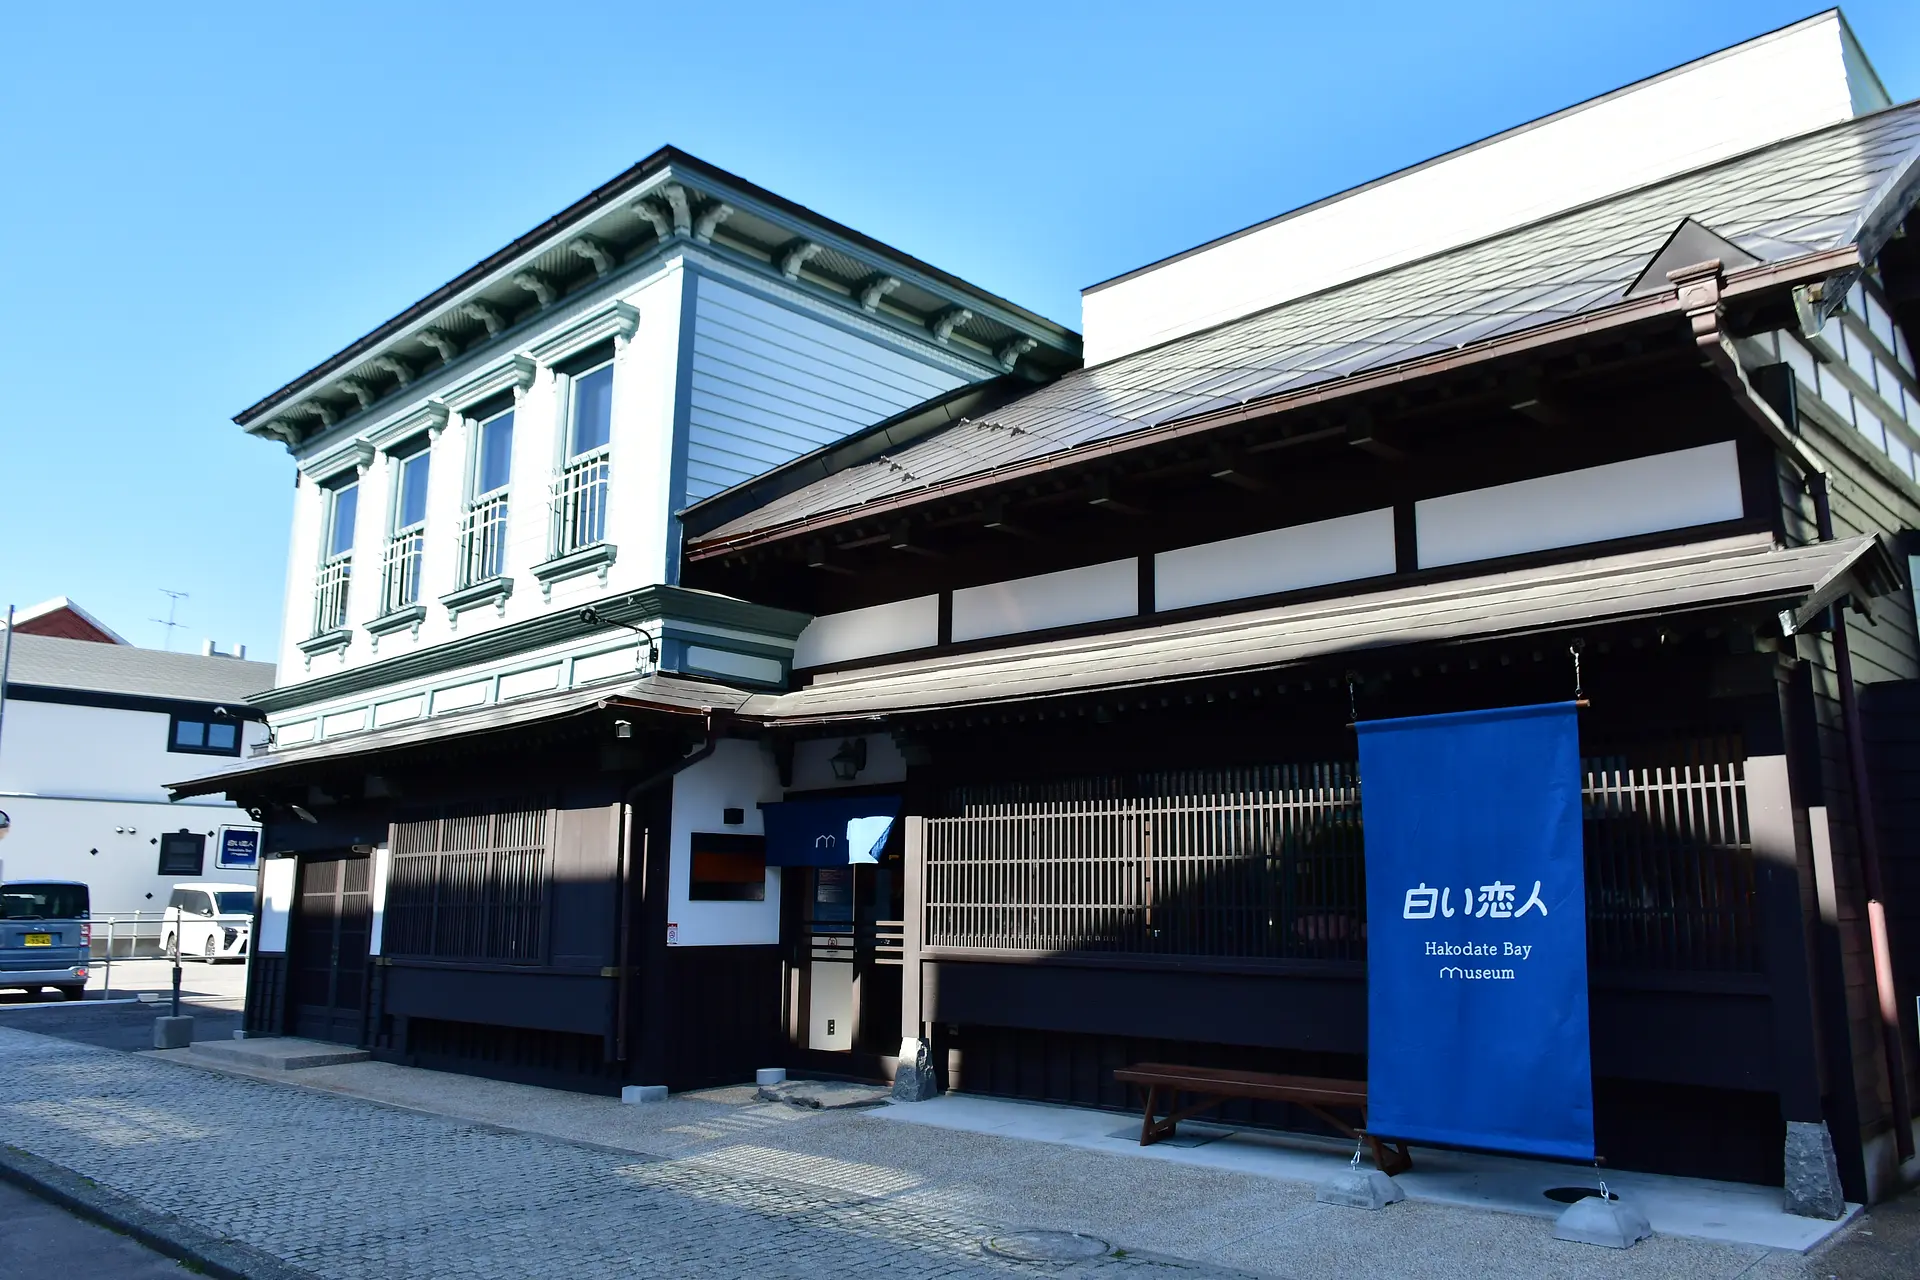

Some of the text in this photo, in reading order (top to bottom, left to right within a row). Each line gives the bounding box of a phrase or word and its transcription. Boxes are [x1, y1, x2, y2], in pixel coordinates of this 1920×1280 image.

[1403, 880, 1548, 920] 白い恋人
[1425, 941, 1533, 960] Hakodate Bay
